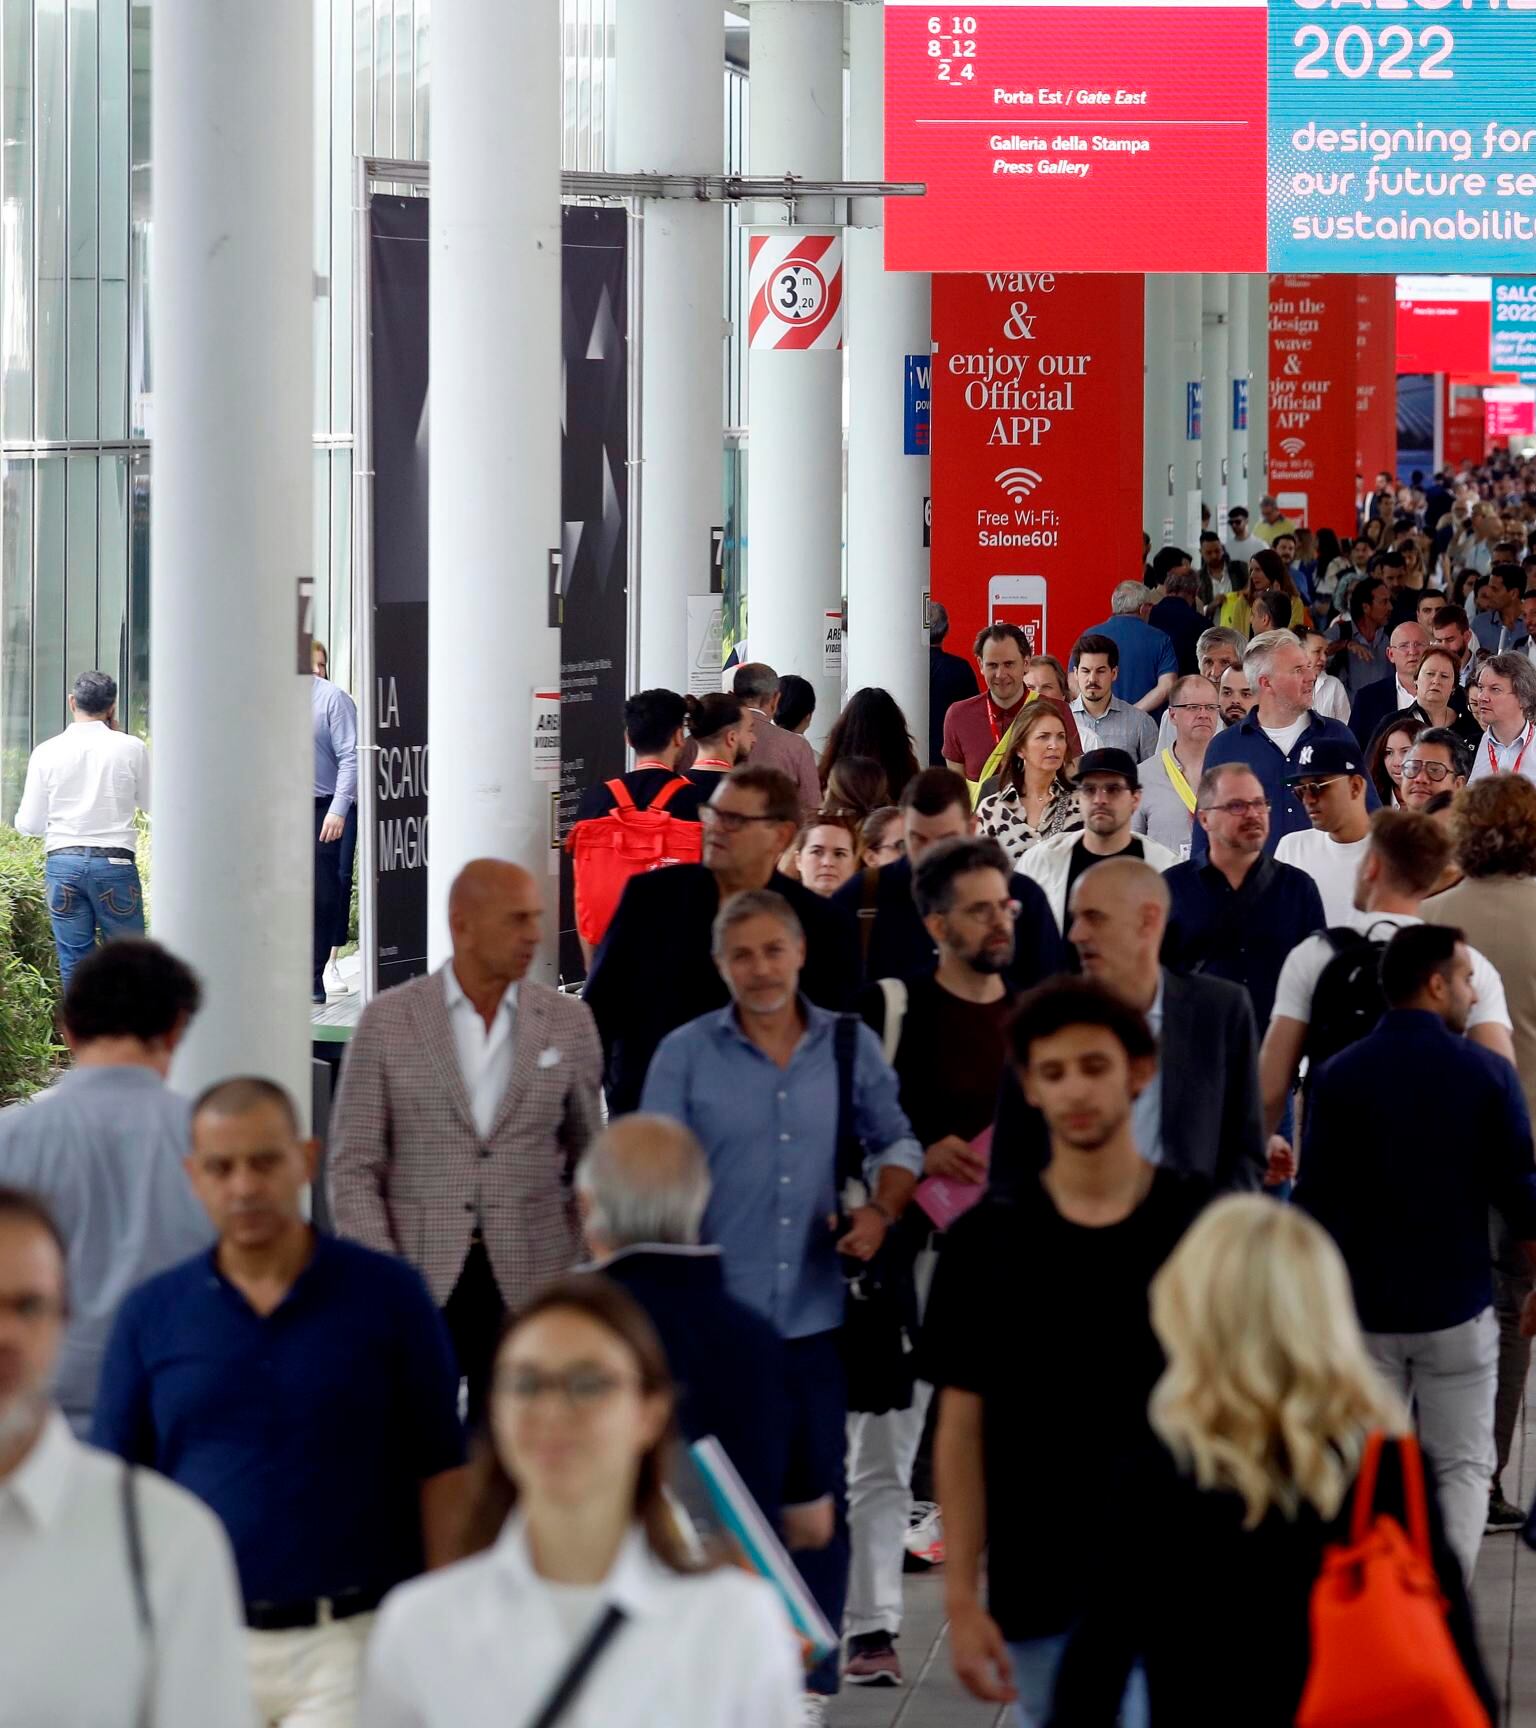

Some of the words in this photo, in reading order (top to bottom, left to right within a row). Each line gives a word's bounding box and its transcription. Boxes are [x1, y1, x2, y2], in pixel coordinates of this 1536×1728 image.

[1294, 25, 1454, 79] 2022
[938, 64, 974, 86] 2_4
[993, 90, 1033, 106] Porta
[1038, 90, 1062, 105] Est
[1076, 90, 1111, 106] Gate
[1114, 90, 1147, 105] East
[990, 135, 1047, 152] Galleria
[1052, 136, 1089, 151] della
[1093, 136, 1150, 154] Stampa
[1292, 124, 1472, 160] designing
[1482, 124, 1536, 160] for
[993, 160, 1033, 176] Press
[1037, 160, 1090, 179] Gallery
[1292, 174, 1354, 197] our
[1364, 166, 1487, 202] future
[780, 275, 798, 308] 3
[802, 277, 812, 286] m
[985, 272, 1055, 292] wave
[1268, 298, 1294, 314] oin
[1299, 298, 1325, 314] the
[1003, 301, 1036, 339] &
[1274, 338, 1312, 351] wave
[948, 347, 1029, 382] enjoy
[1038, 354, 1091, 376] our
[1283, 354, 1302, 376] &
[965, 380, 1074, 411] Official
[1269, 377, 1297, 396] njoy
[1301, 380, 1332, 394] our
[987, 416, 1051, 446] APP
[1276, 412, 1311, 429] APP
[977, 510, 1009, 526] Free
[1015, 510, 1060, 526] Wi-Fi:
[978, 531, 1058, 547] Salone60!
[378, 676, 400, 729] LA
